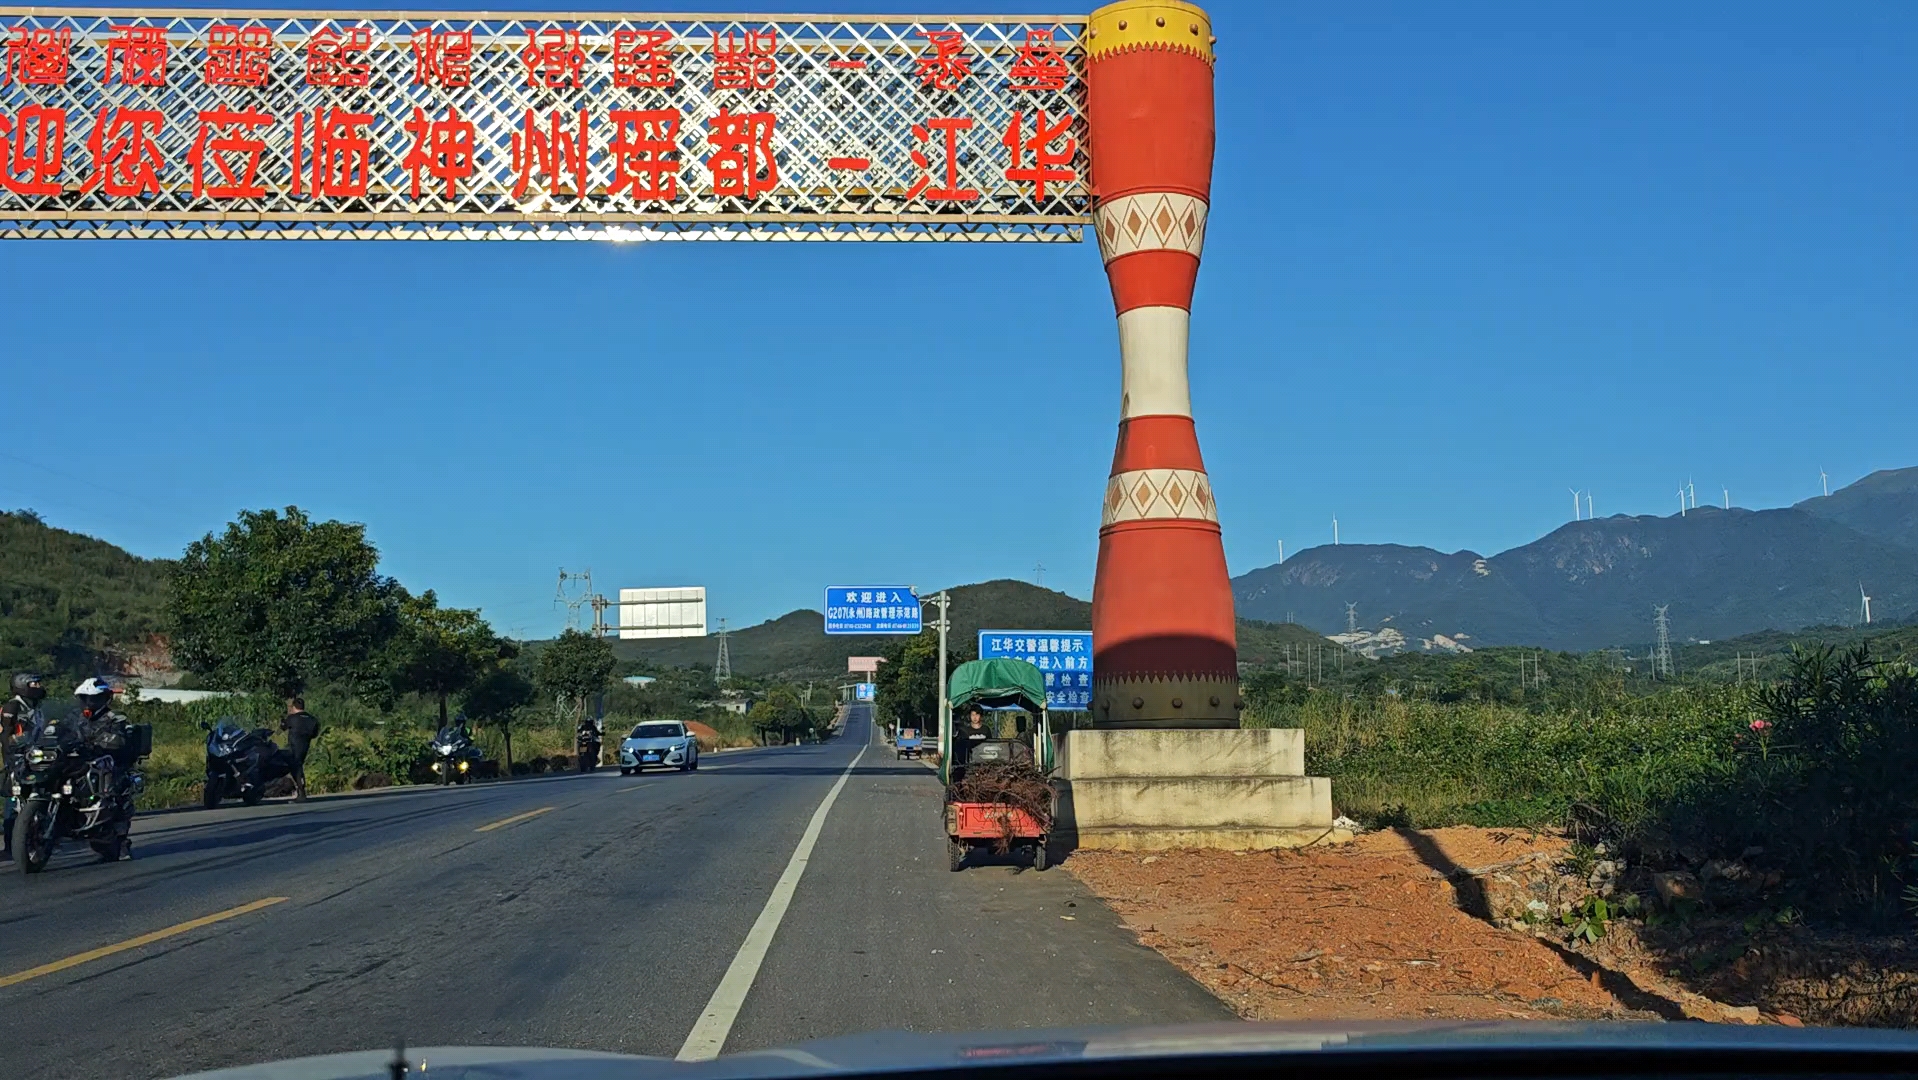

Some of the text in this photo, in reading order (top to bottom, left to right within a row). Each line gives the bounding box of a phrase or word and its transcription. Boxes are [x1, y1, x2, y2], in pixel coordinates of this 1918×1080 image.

[846, 591, 902, 603] 欢迎进入
[991, 637, 1084, 653] 江华交警温馨提示
[1046, 691, 1090, 704] 安全检查
